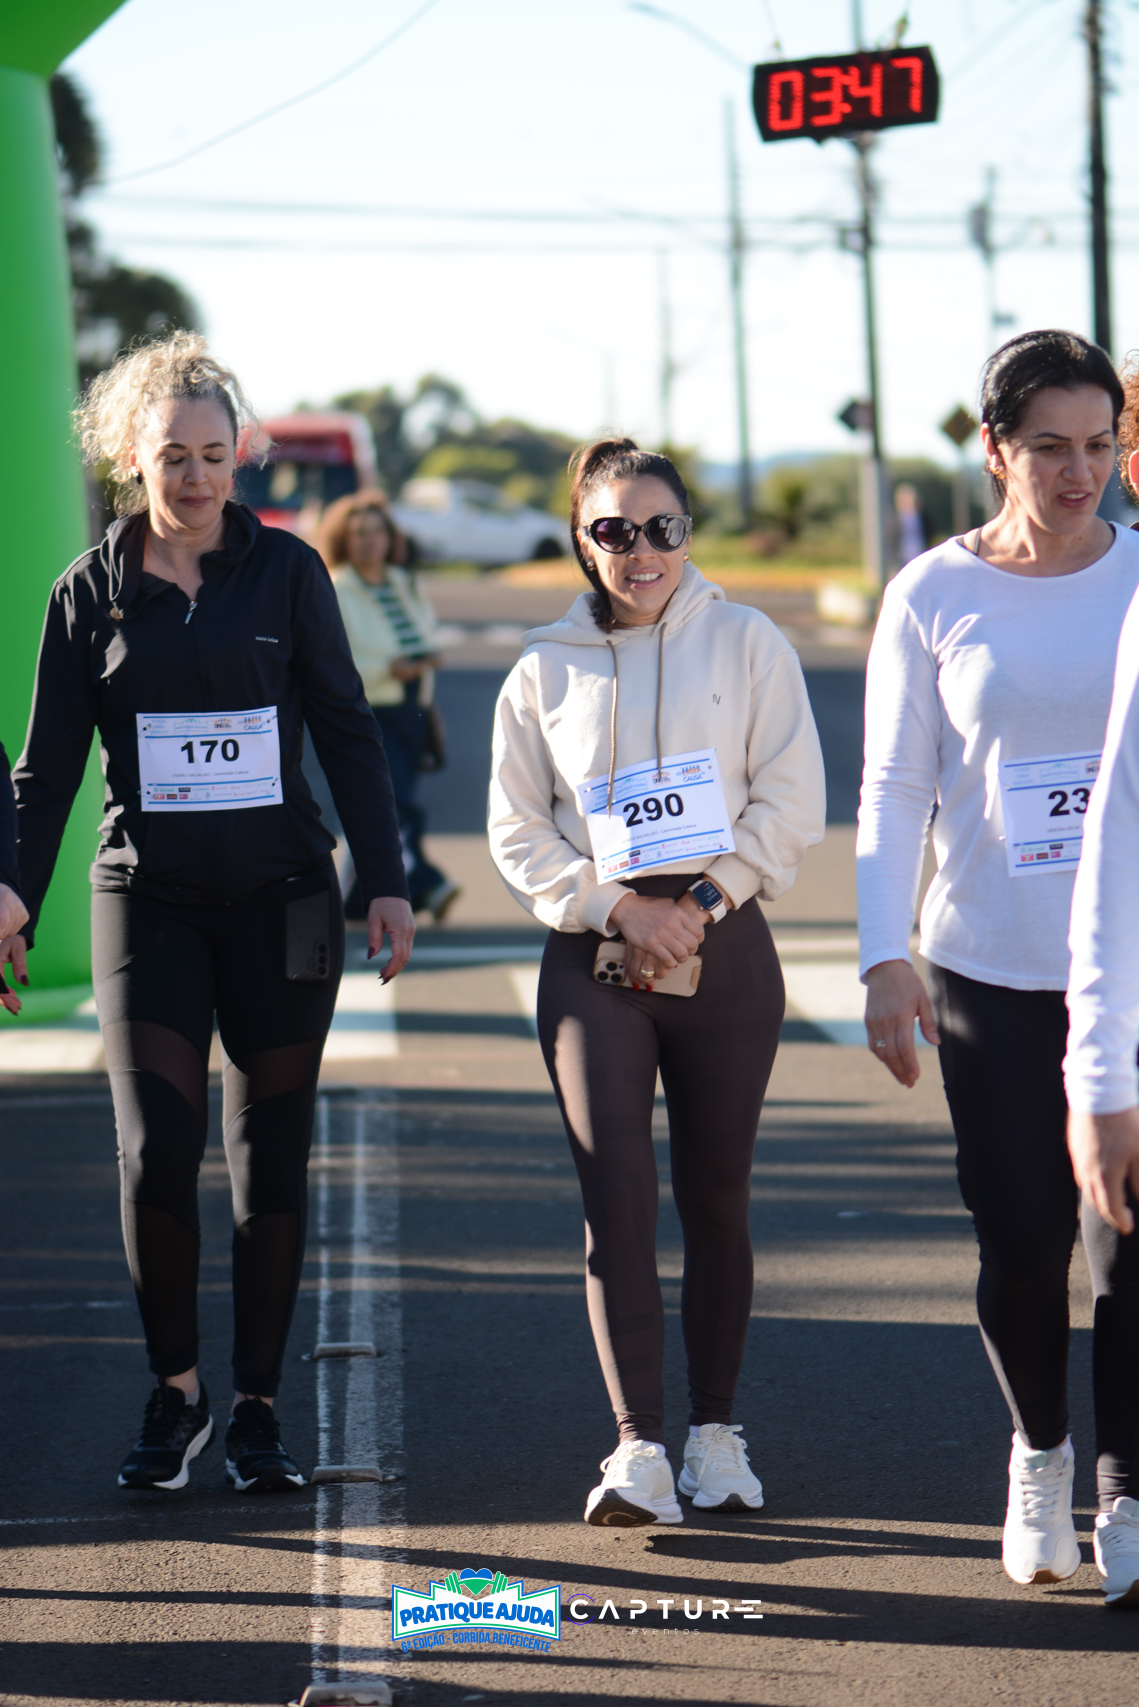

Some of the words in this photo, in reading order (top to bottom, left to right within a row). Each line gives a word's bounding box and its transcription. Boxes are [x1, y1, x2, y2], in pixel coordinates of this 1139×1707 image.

[768, 56, 923, 131] 03:47
[180, 738, 240, 764] 170
[622, 792, 684, 828] 290
[1048, 788, 1090, 817] 23
